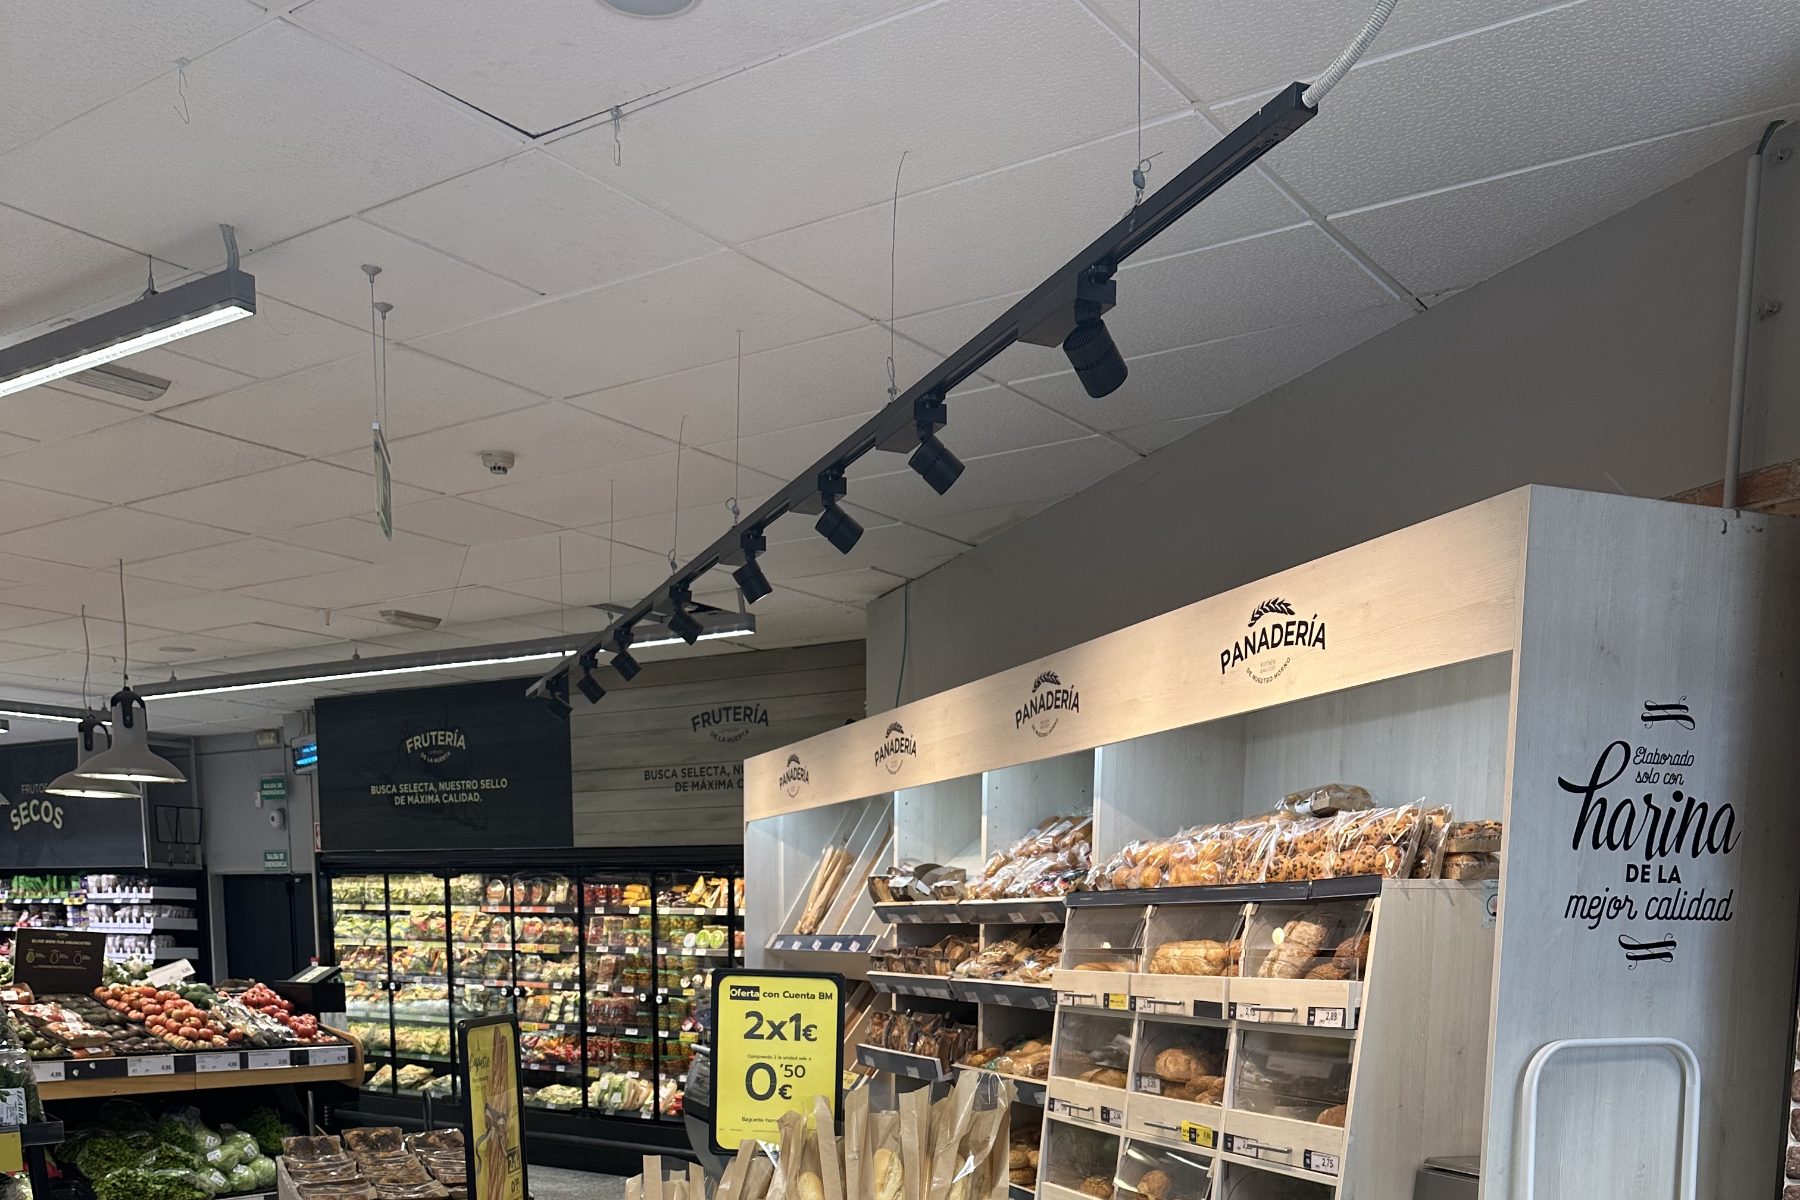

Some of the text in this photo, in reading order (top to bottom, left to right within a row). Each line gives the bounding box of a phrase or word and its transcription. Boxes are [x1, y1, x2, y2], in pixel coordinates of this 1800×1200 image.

[1220, 613, 1326, 675] PANADERÍA
[691, 703, 769, 732] FRUTERÍA
[1015, 684, 1079, 730] PANADERÍA
[406, 729, 466, 753] FRUTERÍA
[874, 734, 917, 767] PANADERÍA
[1633, 746, 1695, 767] Elaborado
[644, 769, 678, 781] BUSCA
[681, 765, 730, 779] SELECTA,
[675, 781, 688, 792] DE
[692, 778, 734, 791] MÁXIMA
[779, 765, 809, 790] PANADERÍA
[1635, 768, 1685, 785] solo con
[370, 778, 508, 795] BUSCA SELECTA, NUESTRO SELLO
[394, 792, 482, 806] DE MÁXIMA CALIDAD.
[1558, 740, 1742, 861] harina
[10, 799, 63, 831] SECOS
[1625, 864, 1682, 884] DE LA
[1564, 887, 1734, 930] mejor calidad
[730, 988, 833, 1000] Oferta con Cuenta BM
[743, 1010, 818, 1042] 2x1€
